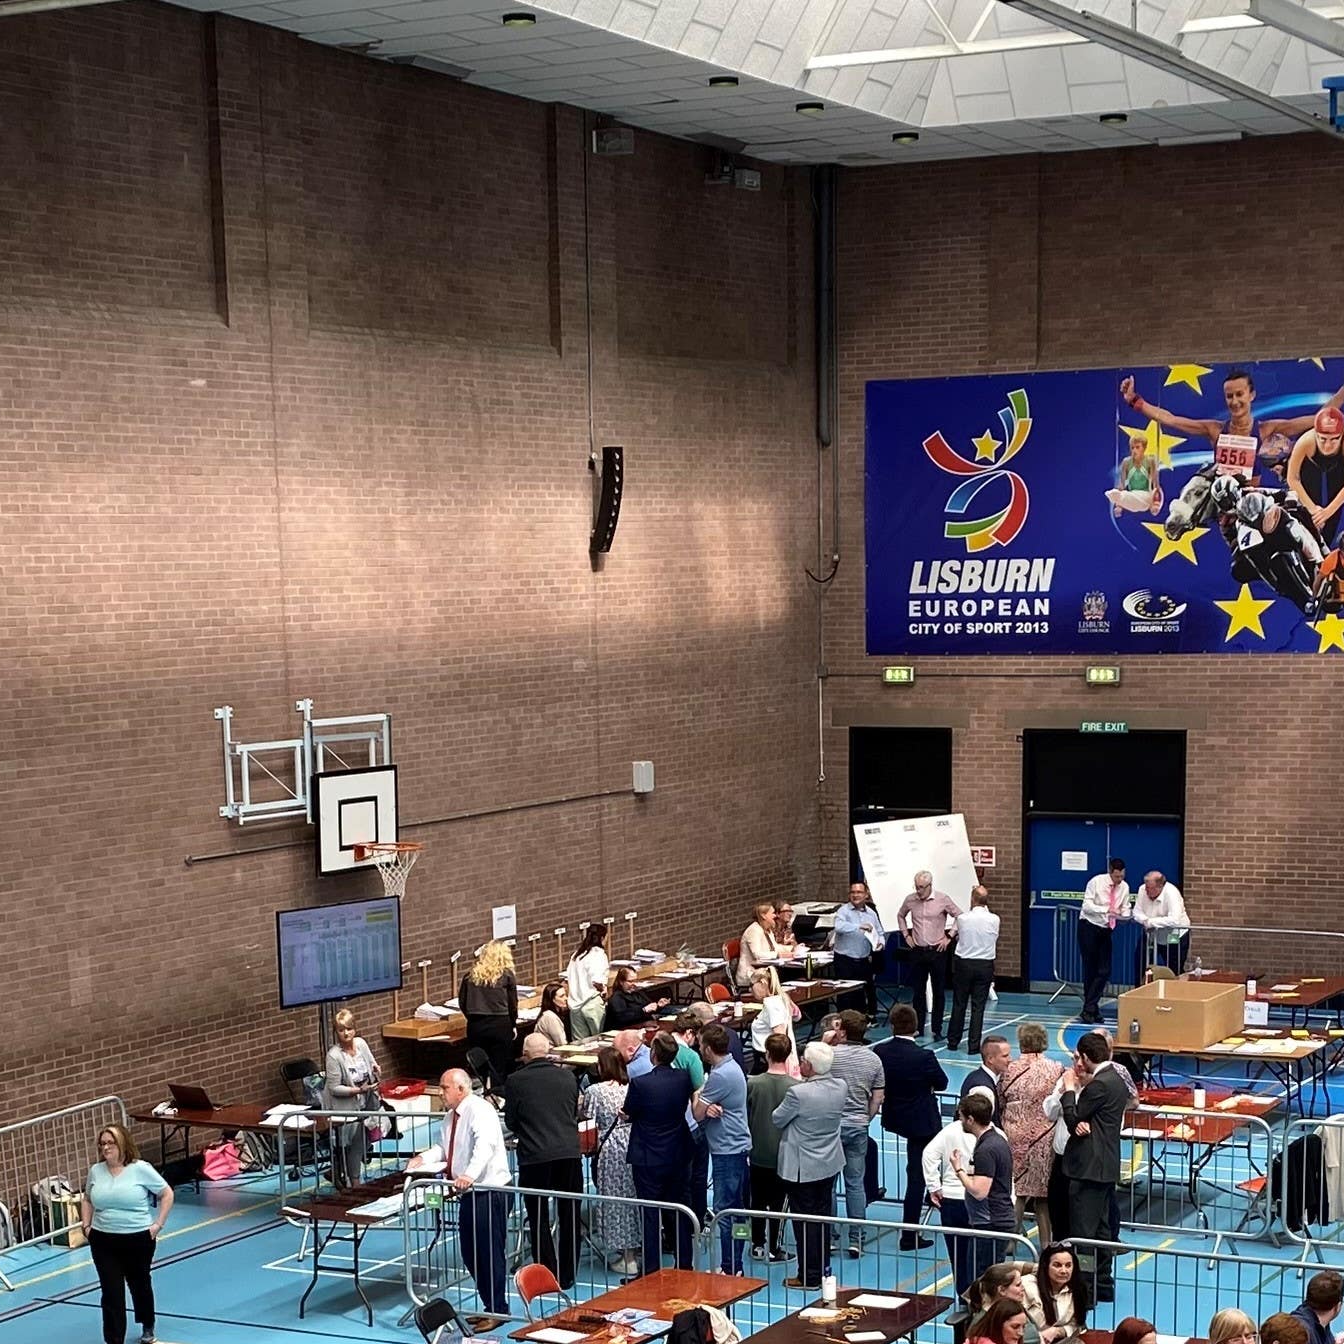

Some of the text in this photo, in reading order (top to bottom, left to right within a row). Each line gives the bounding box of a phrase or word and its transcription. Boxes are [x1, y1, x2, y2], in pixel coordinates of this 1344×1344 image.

[1219, 448, 1247, 466] 556
[909, 558, 1056, 594] LISBURN
[908, 598, 1050, 617] EUROPEAN
[909, 621, 1049, 635] CITY OF SPORT 2013
[1082, 722, 1126, 731] FIRE EXIT
